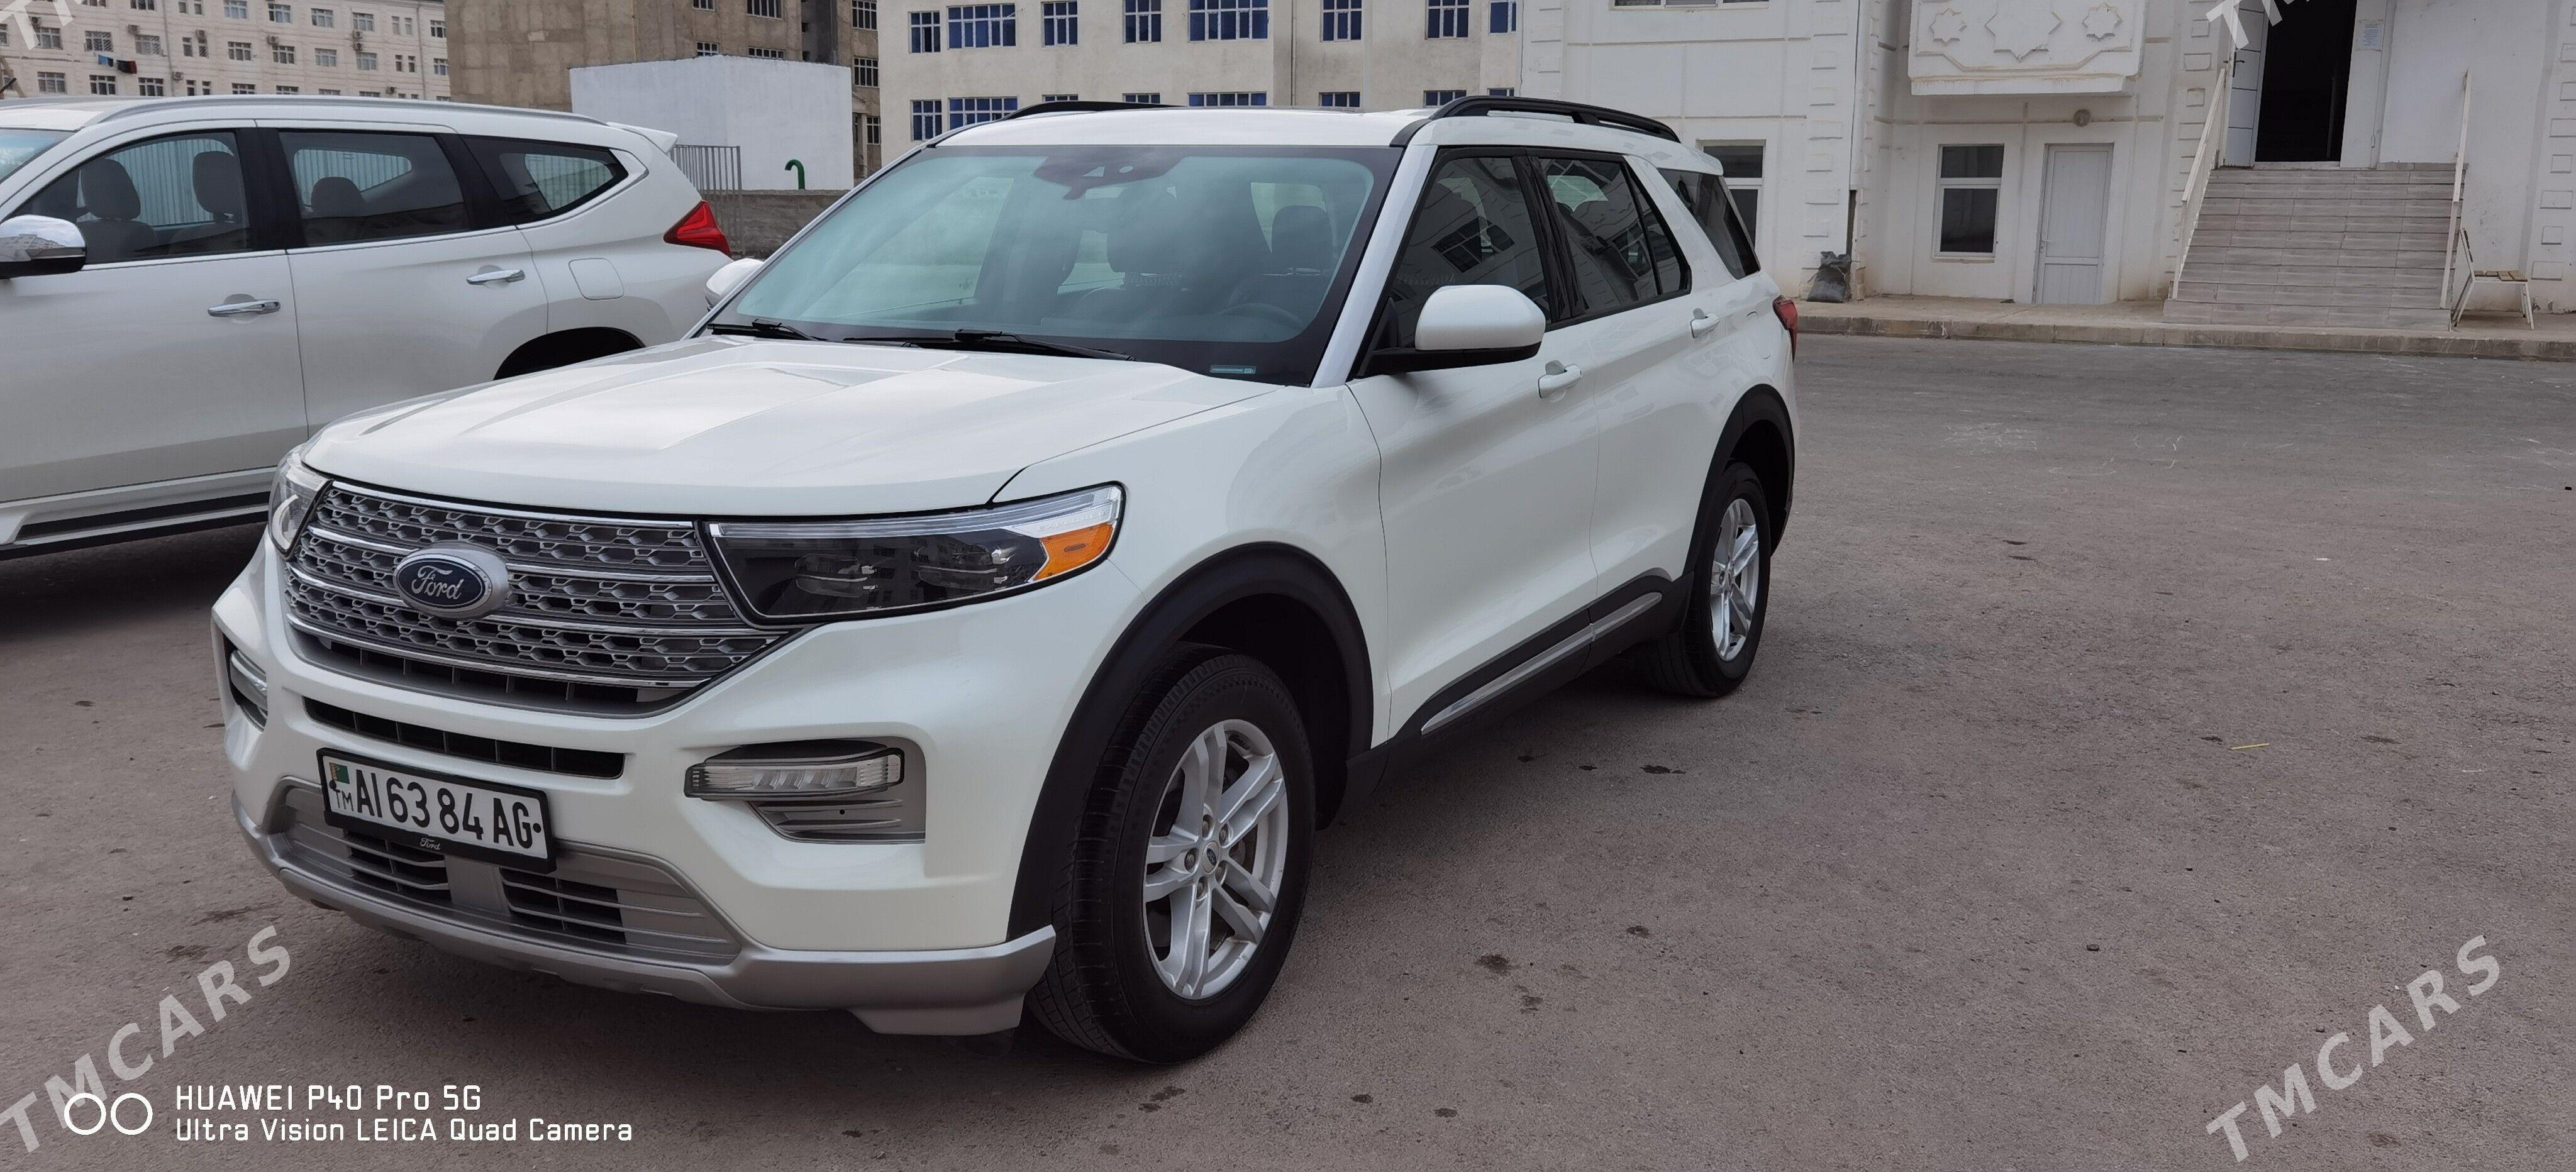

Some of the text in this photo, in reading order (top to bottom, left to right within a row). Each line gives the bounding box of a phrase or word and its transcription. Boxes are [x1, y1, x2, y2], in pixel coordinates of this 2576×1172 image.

[411, 565, 464, 600] Ford
[335, 789, 354, 812] TM
[419, 838, 441, 850] Ford
